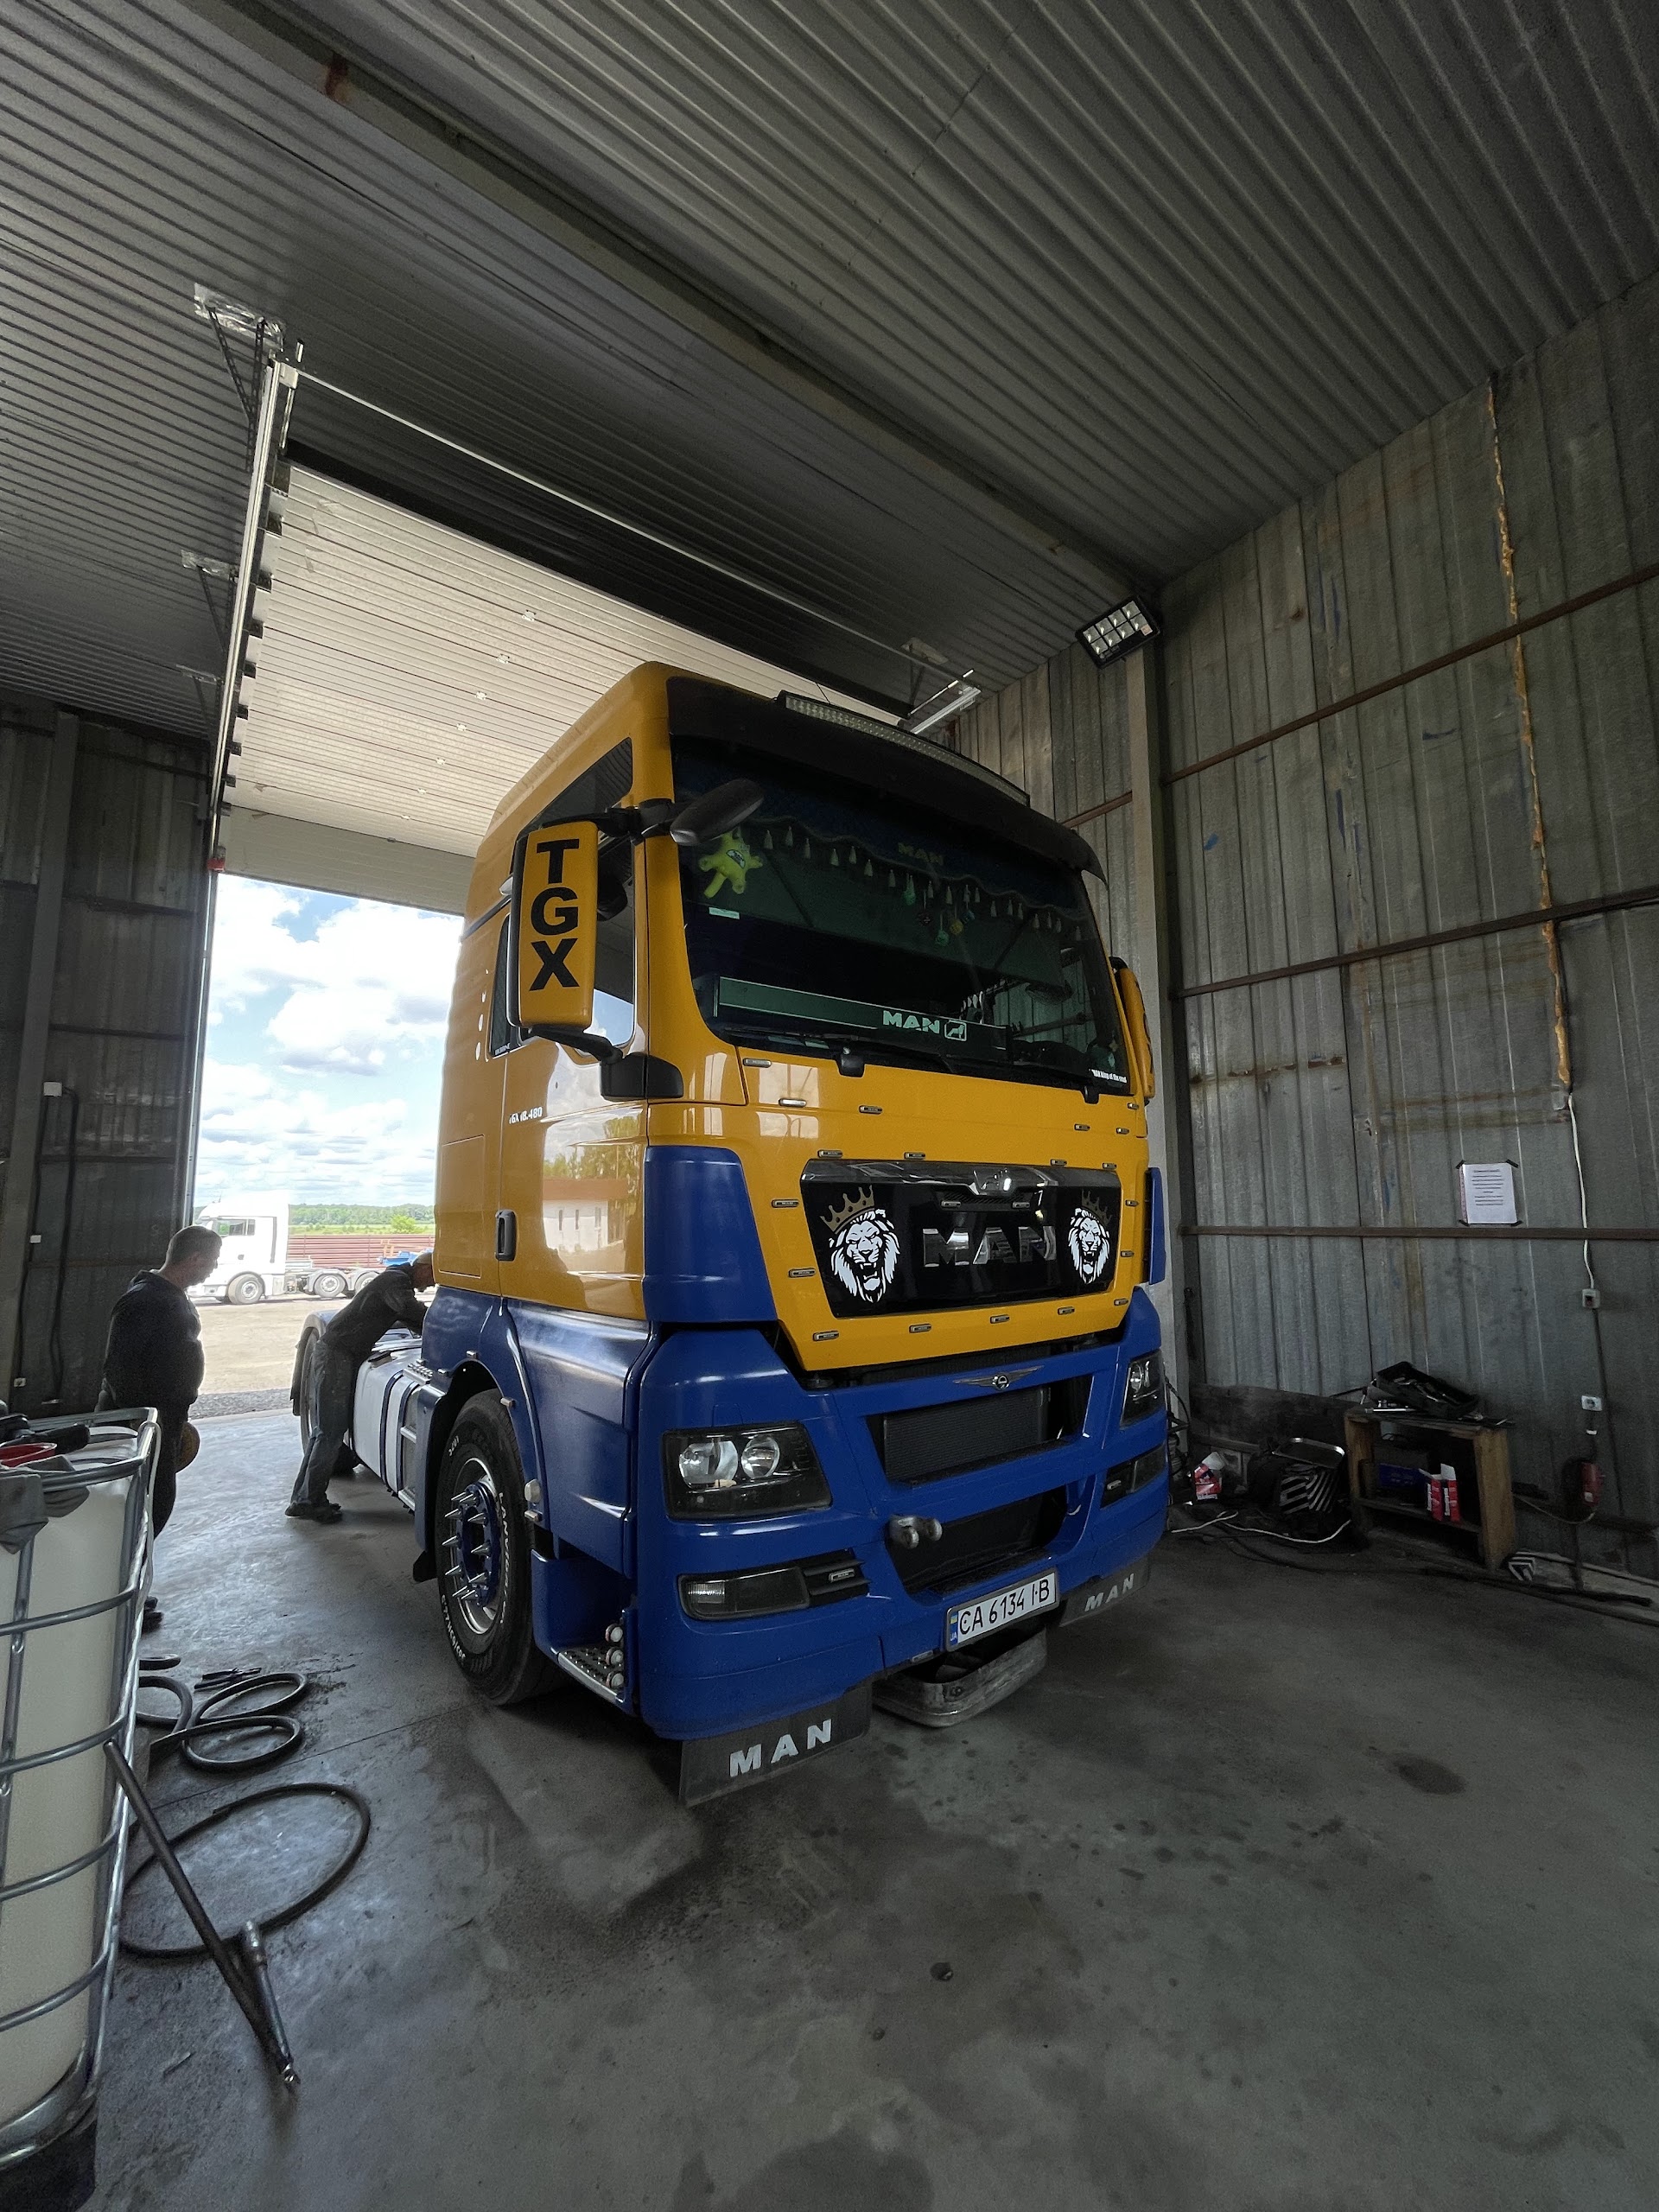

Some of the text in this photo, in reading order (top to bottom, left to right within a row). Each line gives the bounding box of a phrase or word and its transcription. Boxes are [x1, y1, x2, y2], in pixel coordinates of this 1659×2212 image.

[529, 838, 580, 992] TGX
[883, 1010, 940, 1033] MAN
[923, 1226, 1057, 1268] MAN
[959, 1579, 1050, 1635] CA 6134 IB
[1084, 1573, 1134, 1611] MAN
[729, 1719, 831, 1777] MAN
